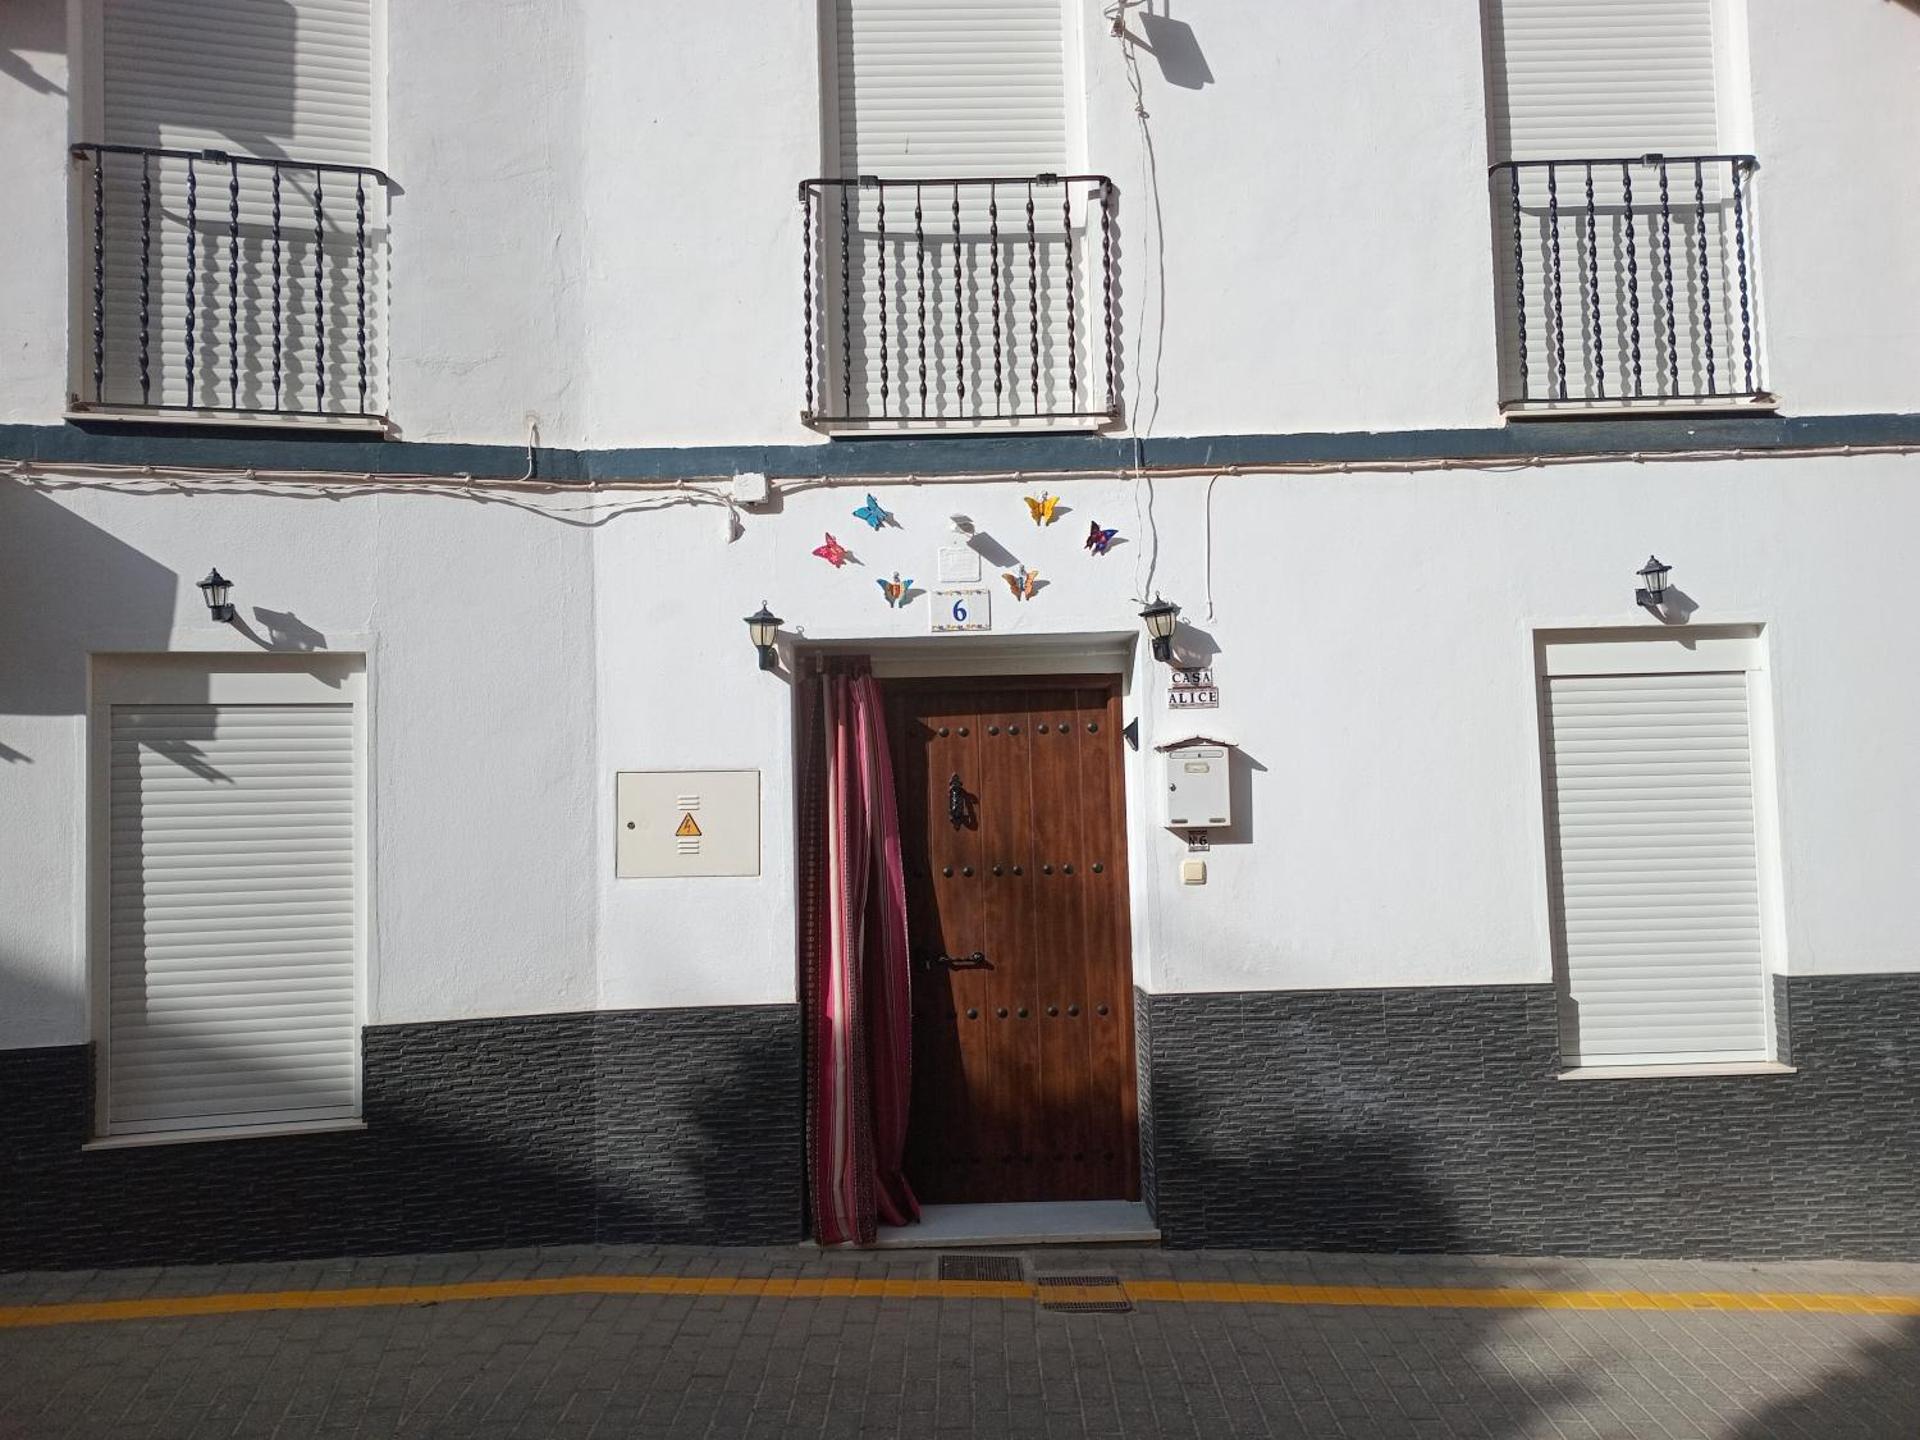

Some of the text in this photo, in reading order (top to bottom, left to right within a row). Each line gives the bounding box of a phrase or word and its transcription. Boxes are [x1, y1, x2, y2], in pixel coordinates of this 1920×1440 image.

[953, 599, 967, 622] 6
[1172, 672, 1211, 683] CASA
[1168, 692, 1217, 704] ALICE
